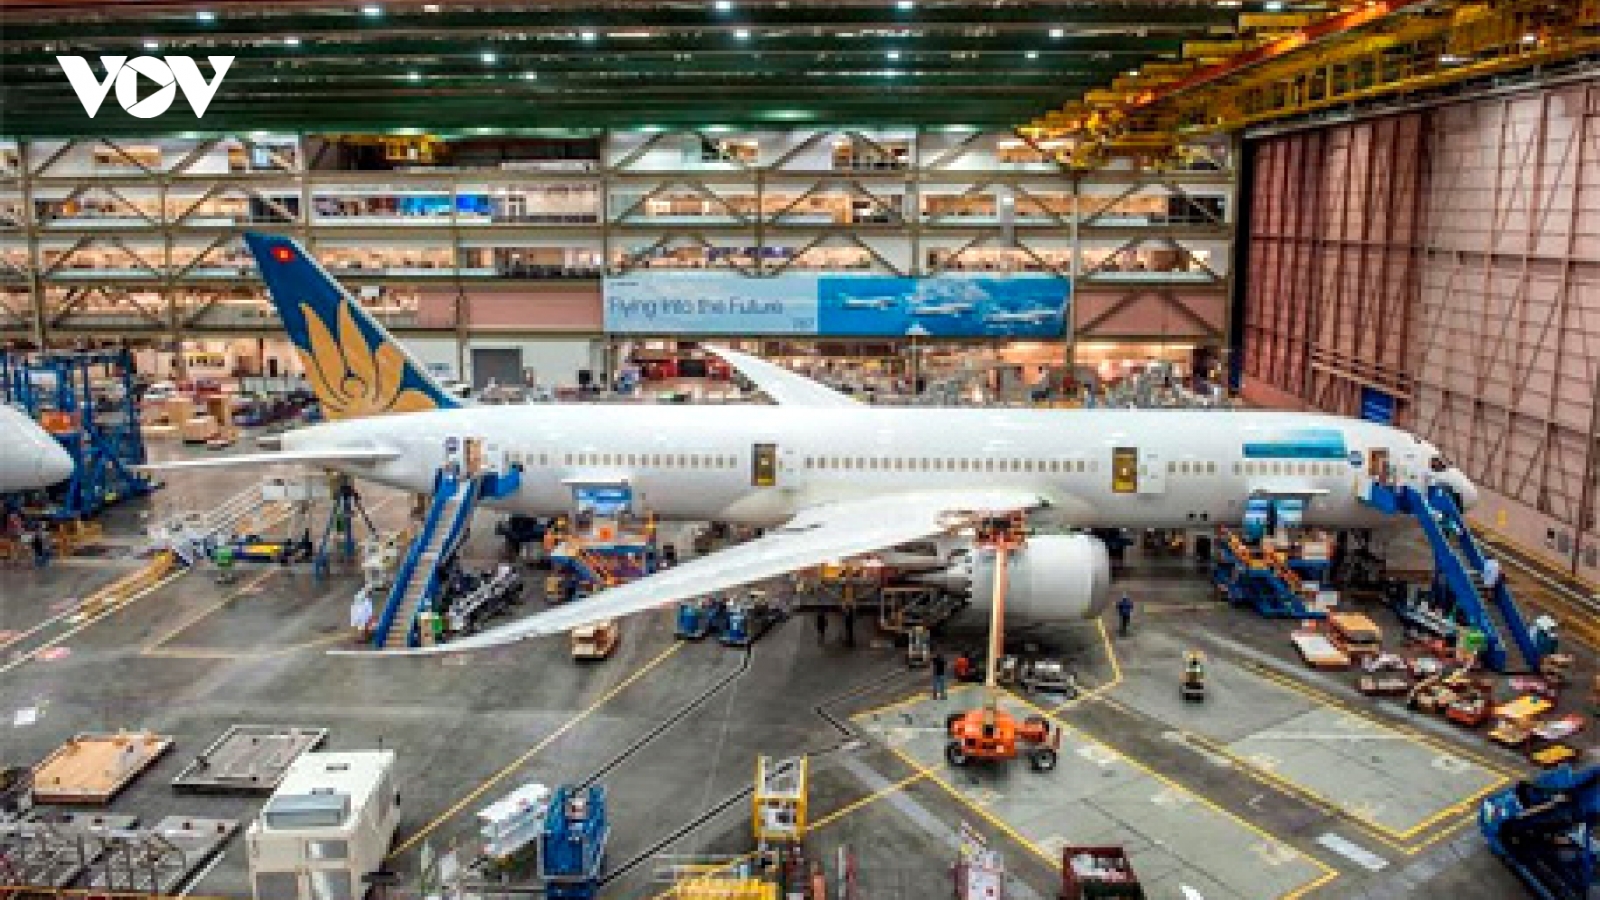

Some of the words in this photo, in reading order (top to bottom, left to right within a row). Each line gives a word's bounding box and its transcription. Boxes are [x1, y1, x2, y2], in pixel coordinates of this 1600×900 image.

[609, 296, 657, 321] Flying
[698, 296, 727, 315] the
[730, 296, 784, 315] Future
